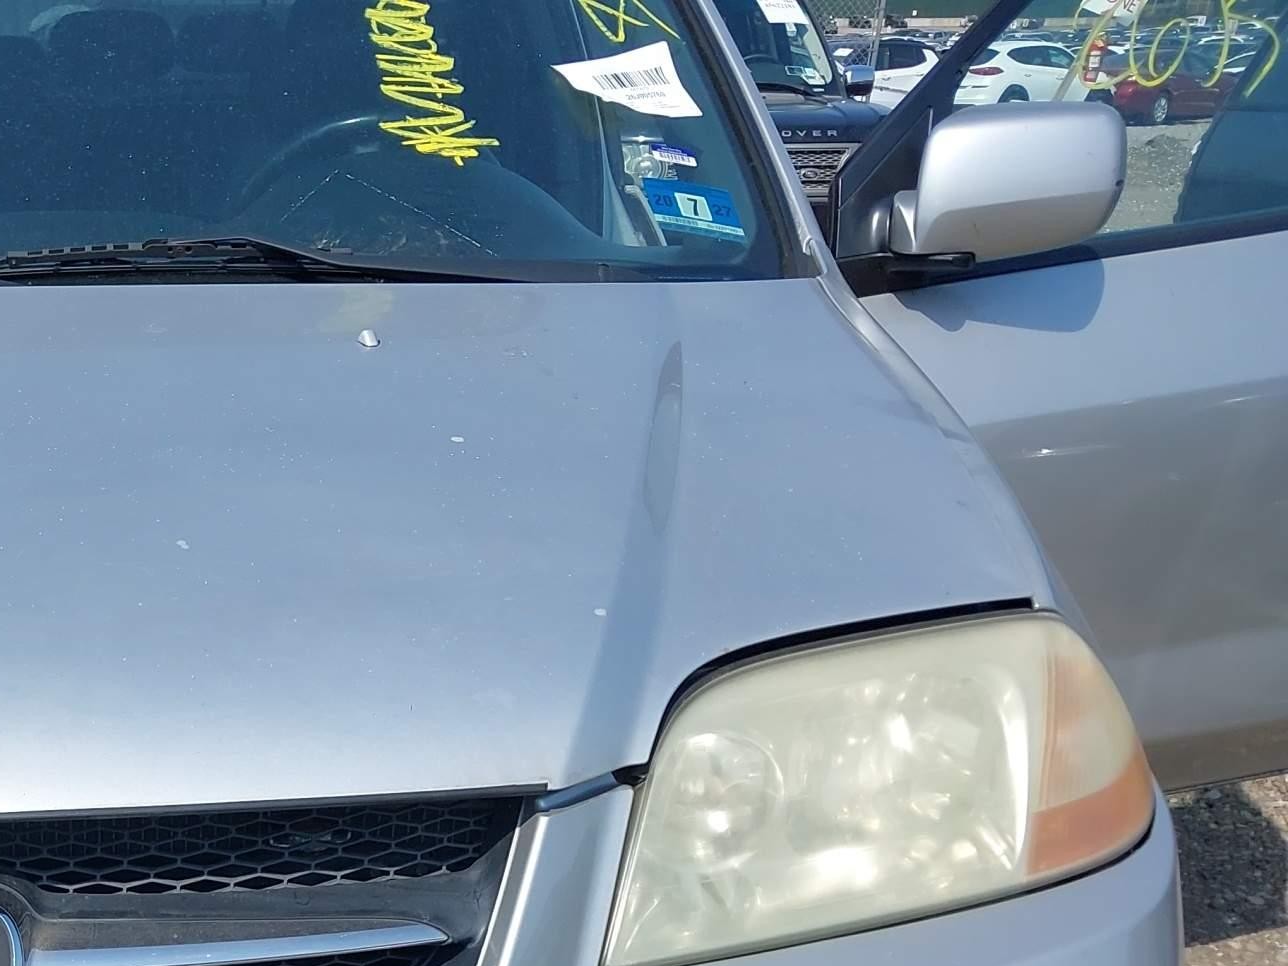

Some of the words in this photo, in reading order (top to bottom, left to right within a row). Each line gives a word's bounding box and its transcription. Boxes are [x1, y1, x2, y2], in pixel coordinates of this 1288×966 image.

[781, 129, 839, 137] OVER
[654, 194, 673, 207] 20
[686, 197, 699, 217] 7
[712, 203, 731, 217] 27
